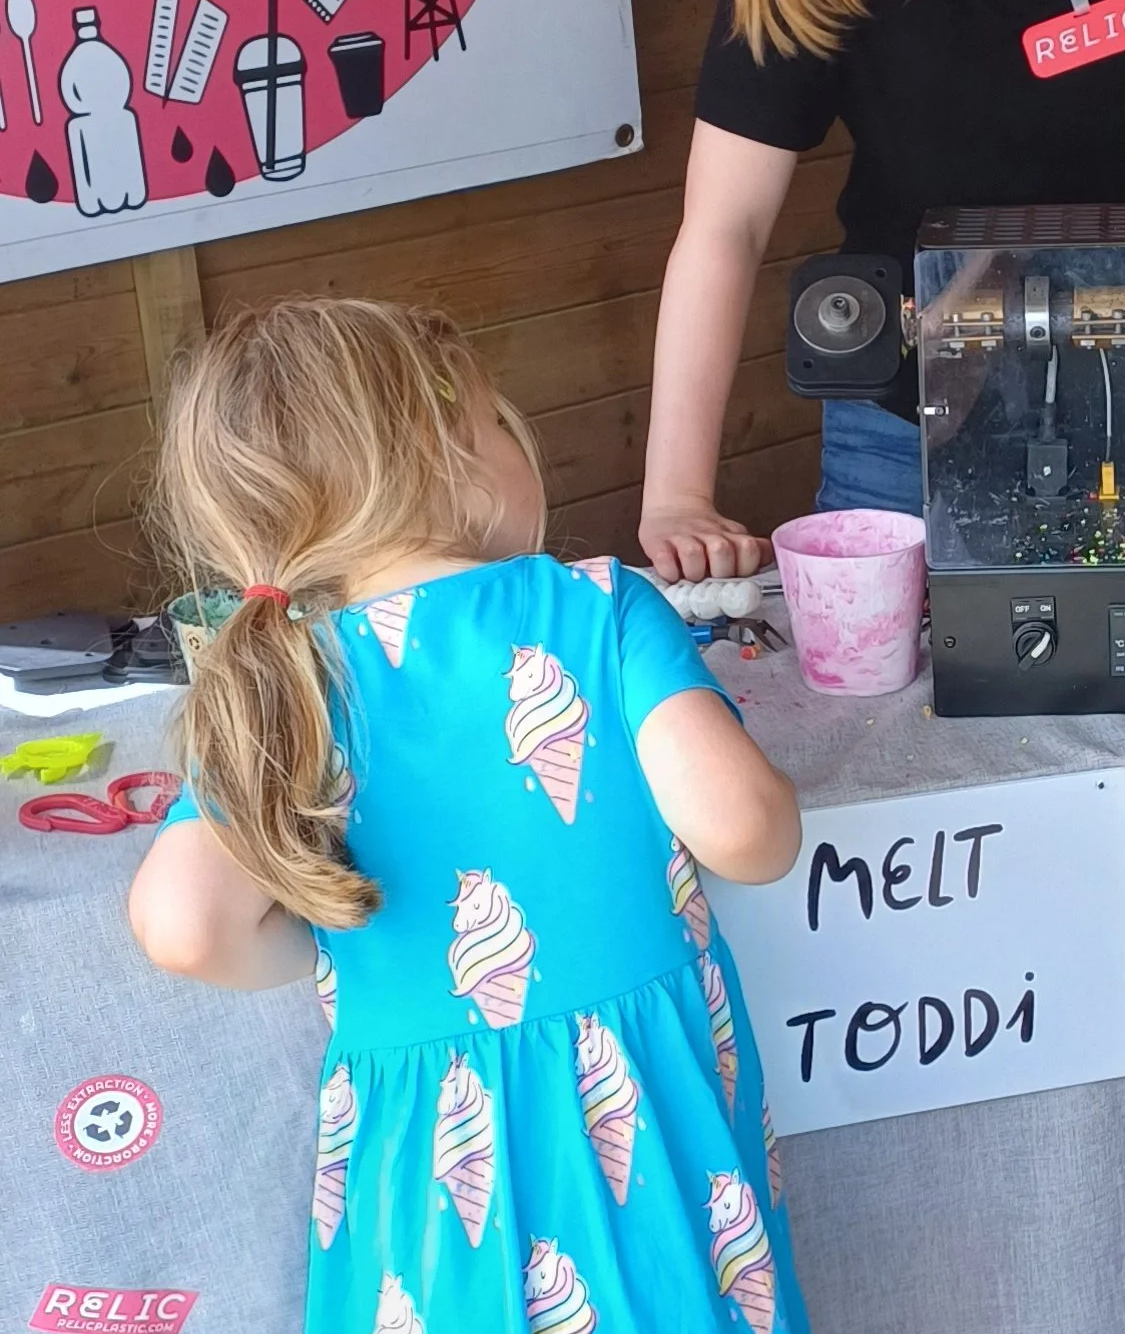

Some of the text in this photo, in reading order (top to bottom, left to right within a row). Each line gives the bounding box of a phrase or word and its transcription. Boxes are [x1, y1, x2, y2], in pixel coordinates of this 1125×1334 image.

[1015, 604, 1052, 613] OFF ON
[806, 823, 1003, 931] MELT
[60, 1079, 144, 1142] LESS EXTRACTION
[72, 1101, 158, 1165] MORE PROACTION
[44, 1288, 188, 1321] RELIC
[56, 1318, 175, 1334] RELICPLASTIC.COM
